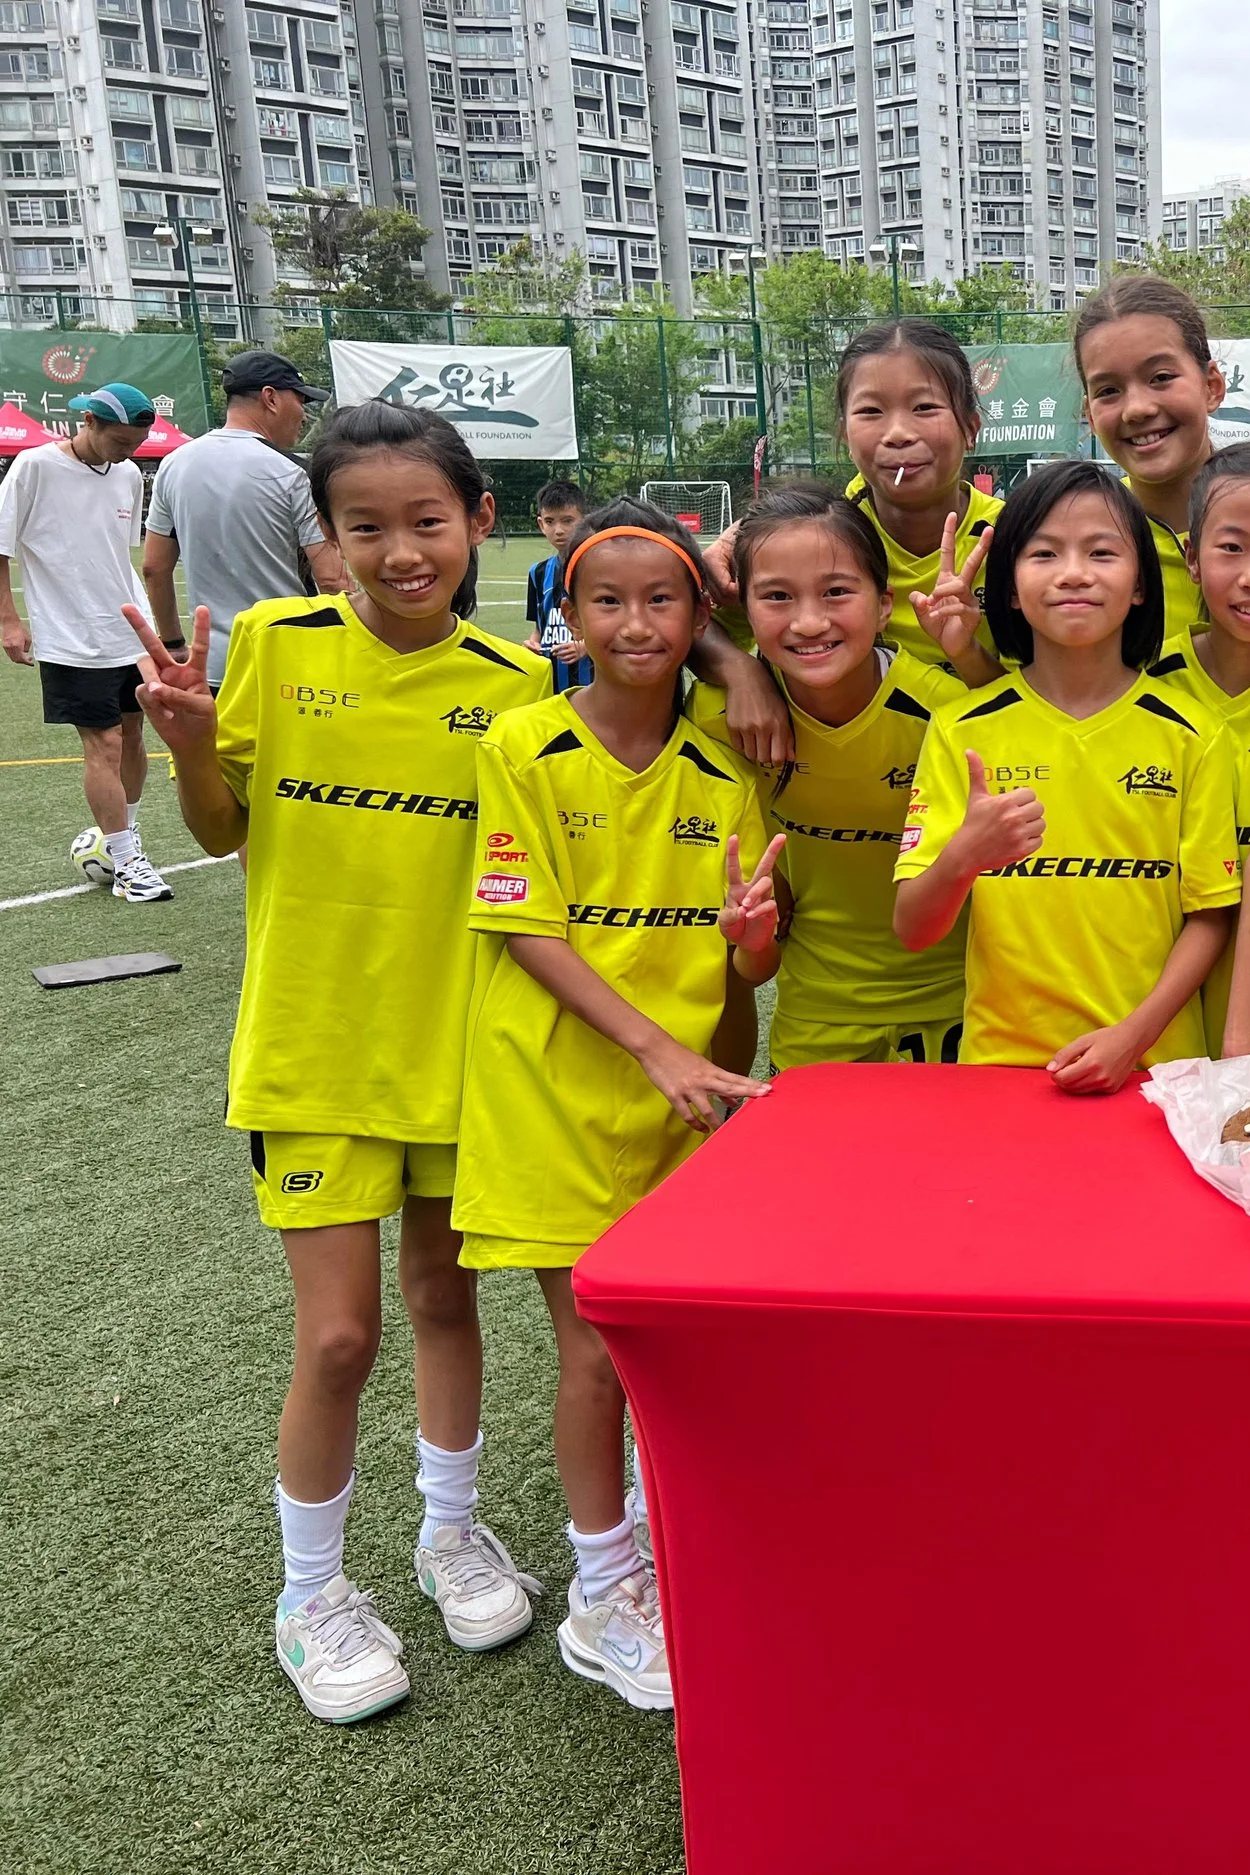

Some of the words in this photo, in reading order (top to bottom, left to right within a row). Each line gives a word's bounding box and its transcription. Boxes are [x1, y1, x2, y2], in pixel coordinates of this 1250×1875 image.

[988, 396, 1058, 420] 基金會
[476, 431, 532, 440] FOUNDATION
[982, 424, 1056, 443] FOUNDATION
[281, 685, 361, 709] OBSE
[557, 811, 607, 828] BSE
